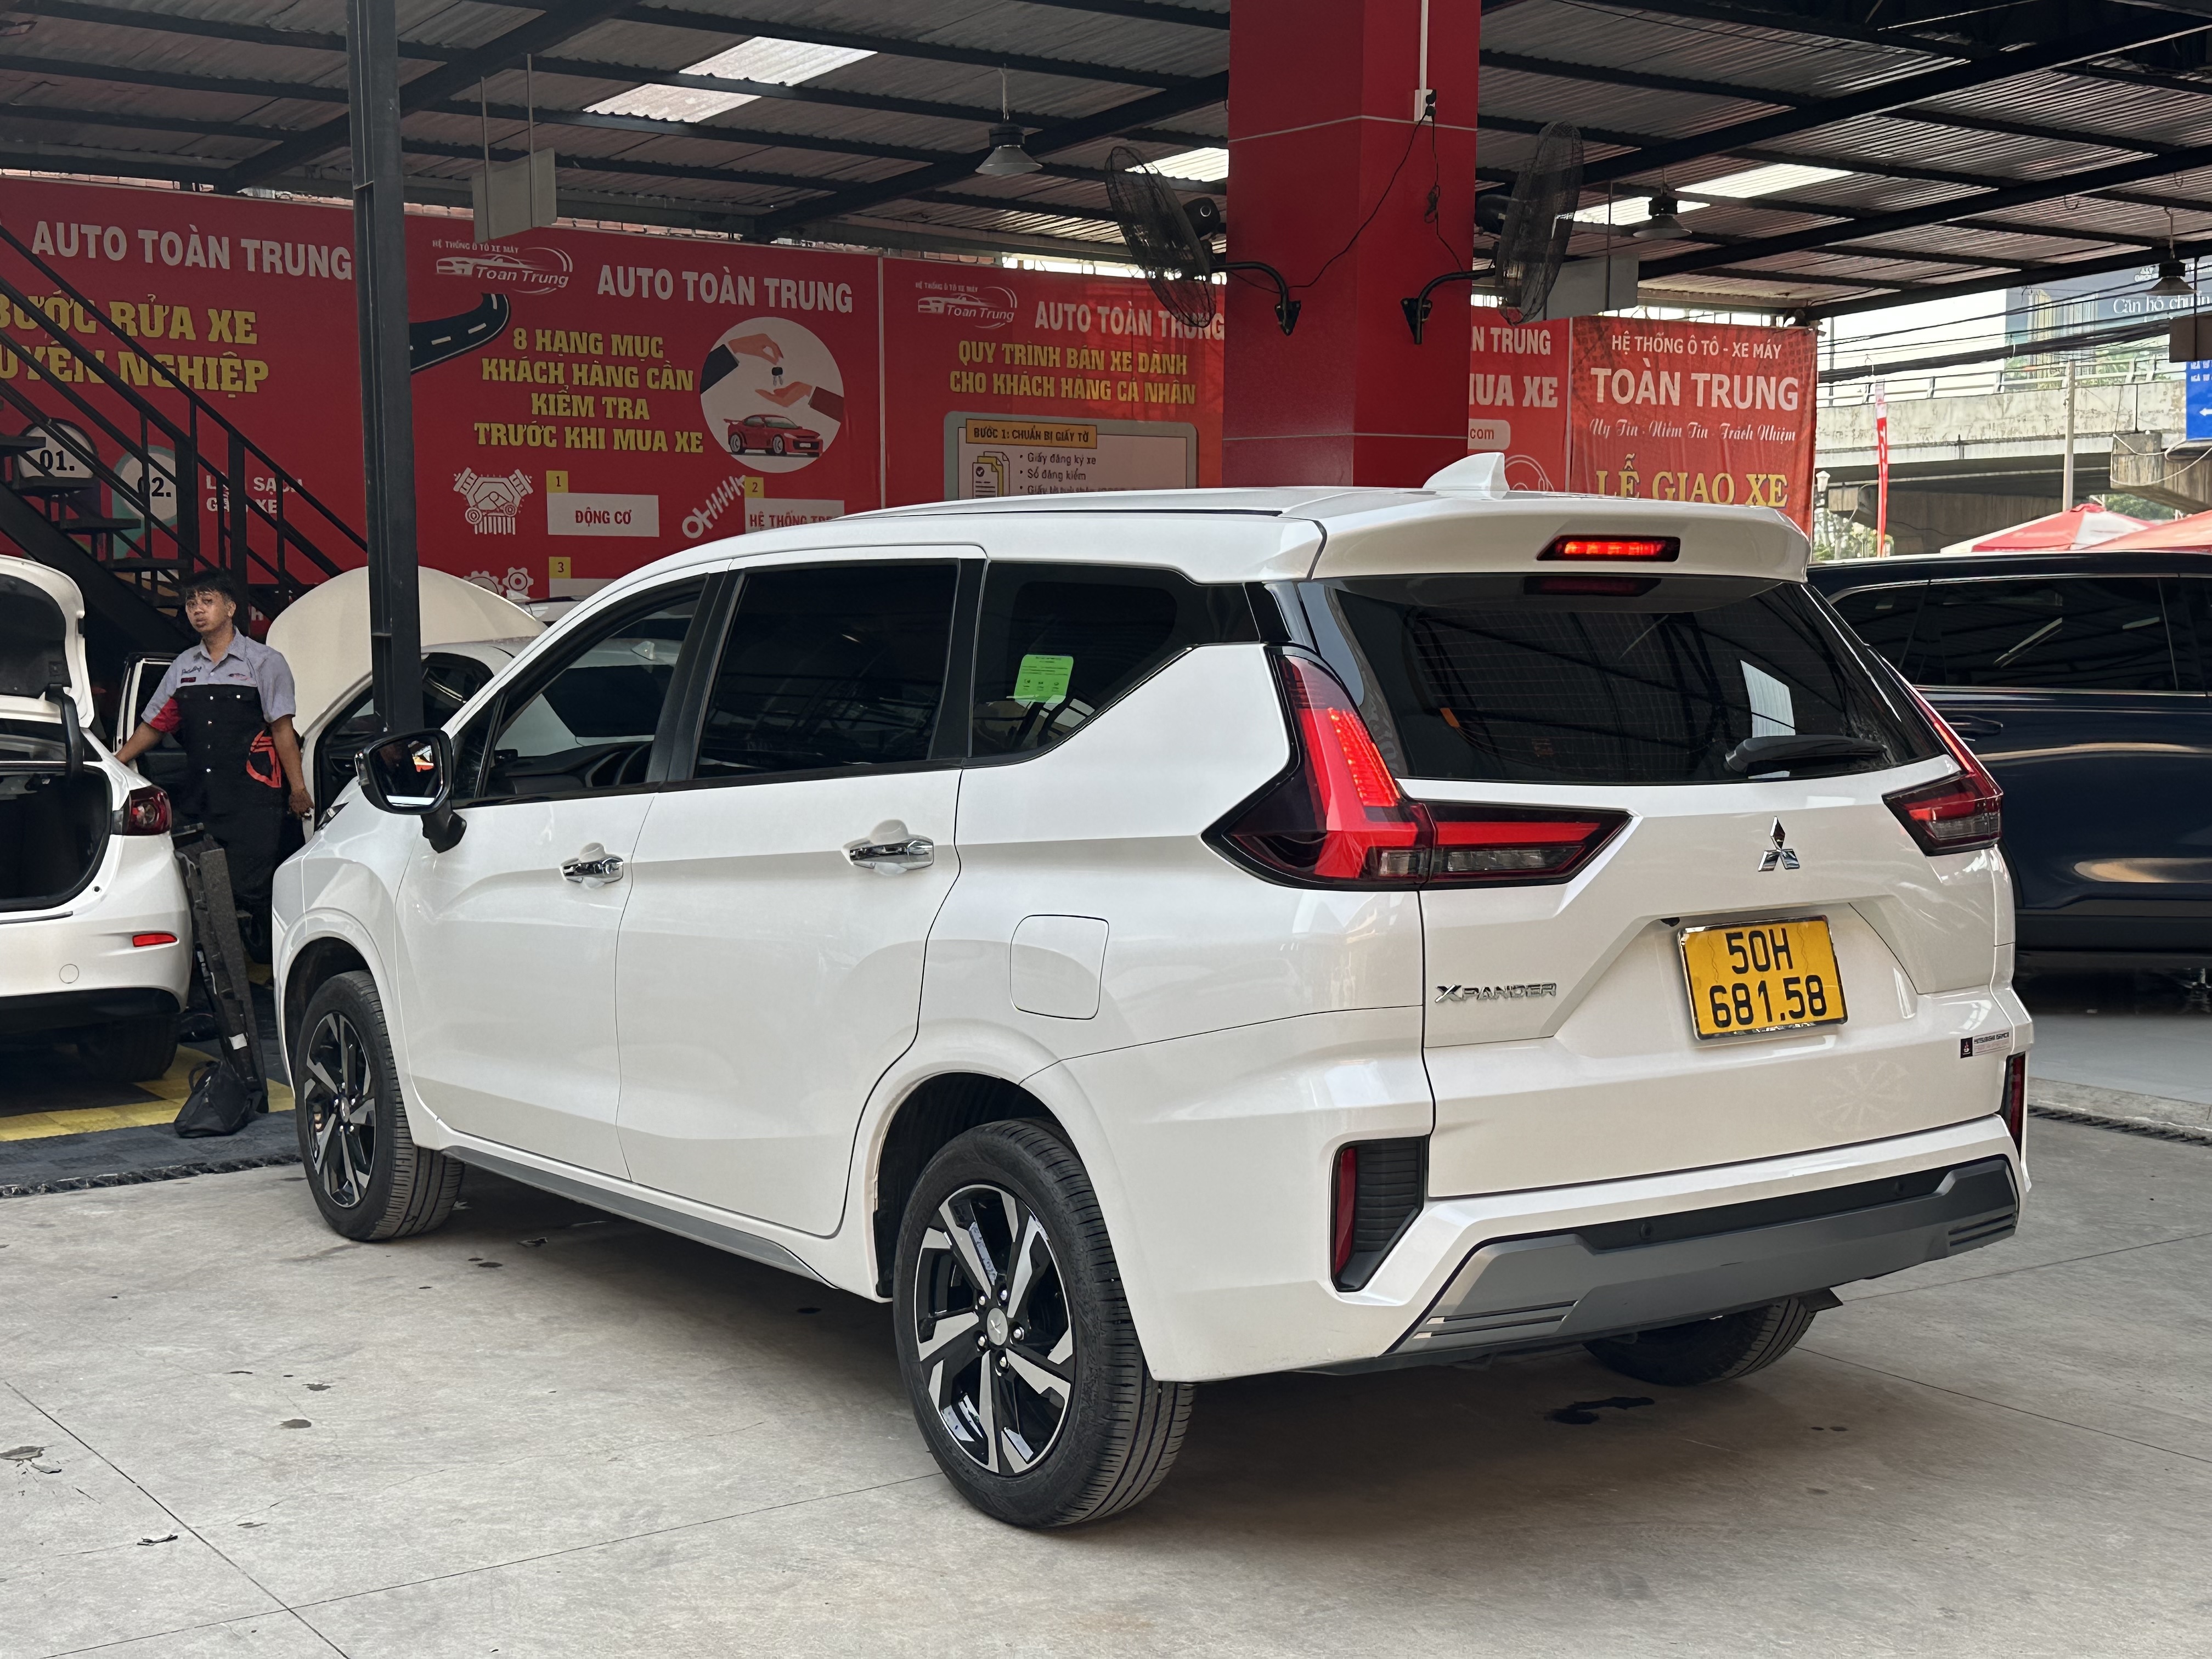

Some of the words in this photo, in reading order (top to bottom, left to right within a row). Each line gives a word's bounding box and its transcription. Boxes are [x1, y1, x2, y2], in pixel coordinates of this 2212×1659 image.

[31, 221, 127, 261] AUTO
[138, 224, 230, 269] TOÀN
[240, 238, 352, 280] TRUNG
[476, 266, 517, 281] Toan
[521, 270, 569, 288] Trung
[597, 265, 673, 300] AUTO
[682, 266, 755, 306] TOÀN
[764, 278, 853, 313] TRUNG
[109, 294, 196, 341] RỬA
[207, 308, 257, 345] XE
[947, 304, 977, 318] Toan
[980, 308, 1015, 323] Trung
[1035, 301, 1091, 332] AUTO
[1097, 301, 1152, 336] TOÀN
[1158, 310, 1224, 340] TRUNG
[514, 328, 527, 350] 8
[535, 329, 603, 357] HẠNG
[611, 334, 664, 362] MỤC
[958, 340, 996, 366] QUY
[1002, 340, 1060, 368] TRÌNH
[1066, 345, 1104, 370] BÁN
[1110, 350, 1132, 372] XE
[1138, 349, 1187, 375] DÀNH
[1490, 327, 1551, 355] TRUNG
[1612, 330, 1630, 356] HỆ
[1634, 331, 1683, 354] THỐNG
[1688, 335, 1697, 355] Ô
[1701, 336, 1719, 356] TÔ
[1732, 342, 1748, 358] XE
[1753, 338, 1781, 359] MÁY
[118, 351, 269, 398] NGHIỆP
[482, 356, 565, 384] KHÁCH
[572, 360, 639, 388] HÀNG
[647, 360, 693, 391] CẦN
[950, 370, 986, 393] CHO
[992, 370, 1055, 397] KHÁCH
[1060, 374, 1111, 400] HÀNG
[1117, 377, 1139, 402] CÁ
[1144, 379, 1196, 404] NHÂN
[1590, 358, 1680, 407] TOÀN
[1690, 373, 1798, 411] TRUNG
[531, 385, 595, 417] KIỂM
[602, 396, 650, 420] TRA
[1522, 376, 1558, 408] XE
[474, 420, 557, 447] TRƯỚC
[565, 426, 606, 450] KHI
[613, 428, 668, 452] MUA
[674, 431, 703, 453] XE
[40, 449, 75, 471] 01.
[556, 476, 561, 487] 1
[752, 482, 758, 493] 2
[1596, 453, 1639, 499] LỄ
[1652, 472, 1735, 505] GIAO
[1746, 474, 1788, 507] XE
[575, 507, 610, 527] ĐỘNG
[614, 510, 631, 524] CƠ
[558, 562, 564, 573] 3
[1725, 928, 1793, 974] 50H
[1435, 983, 1557, 1003] XPANDER
[1709, 974, 1827, 1028] 681.58
